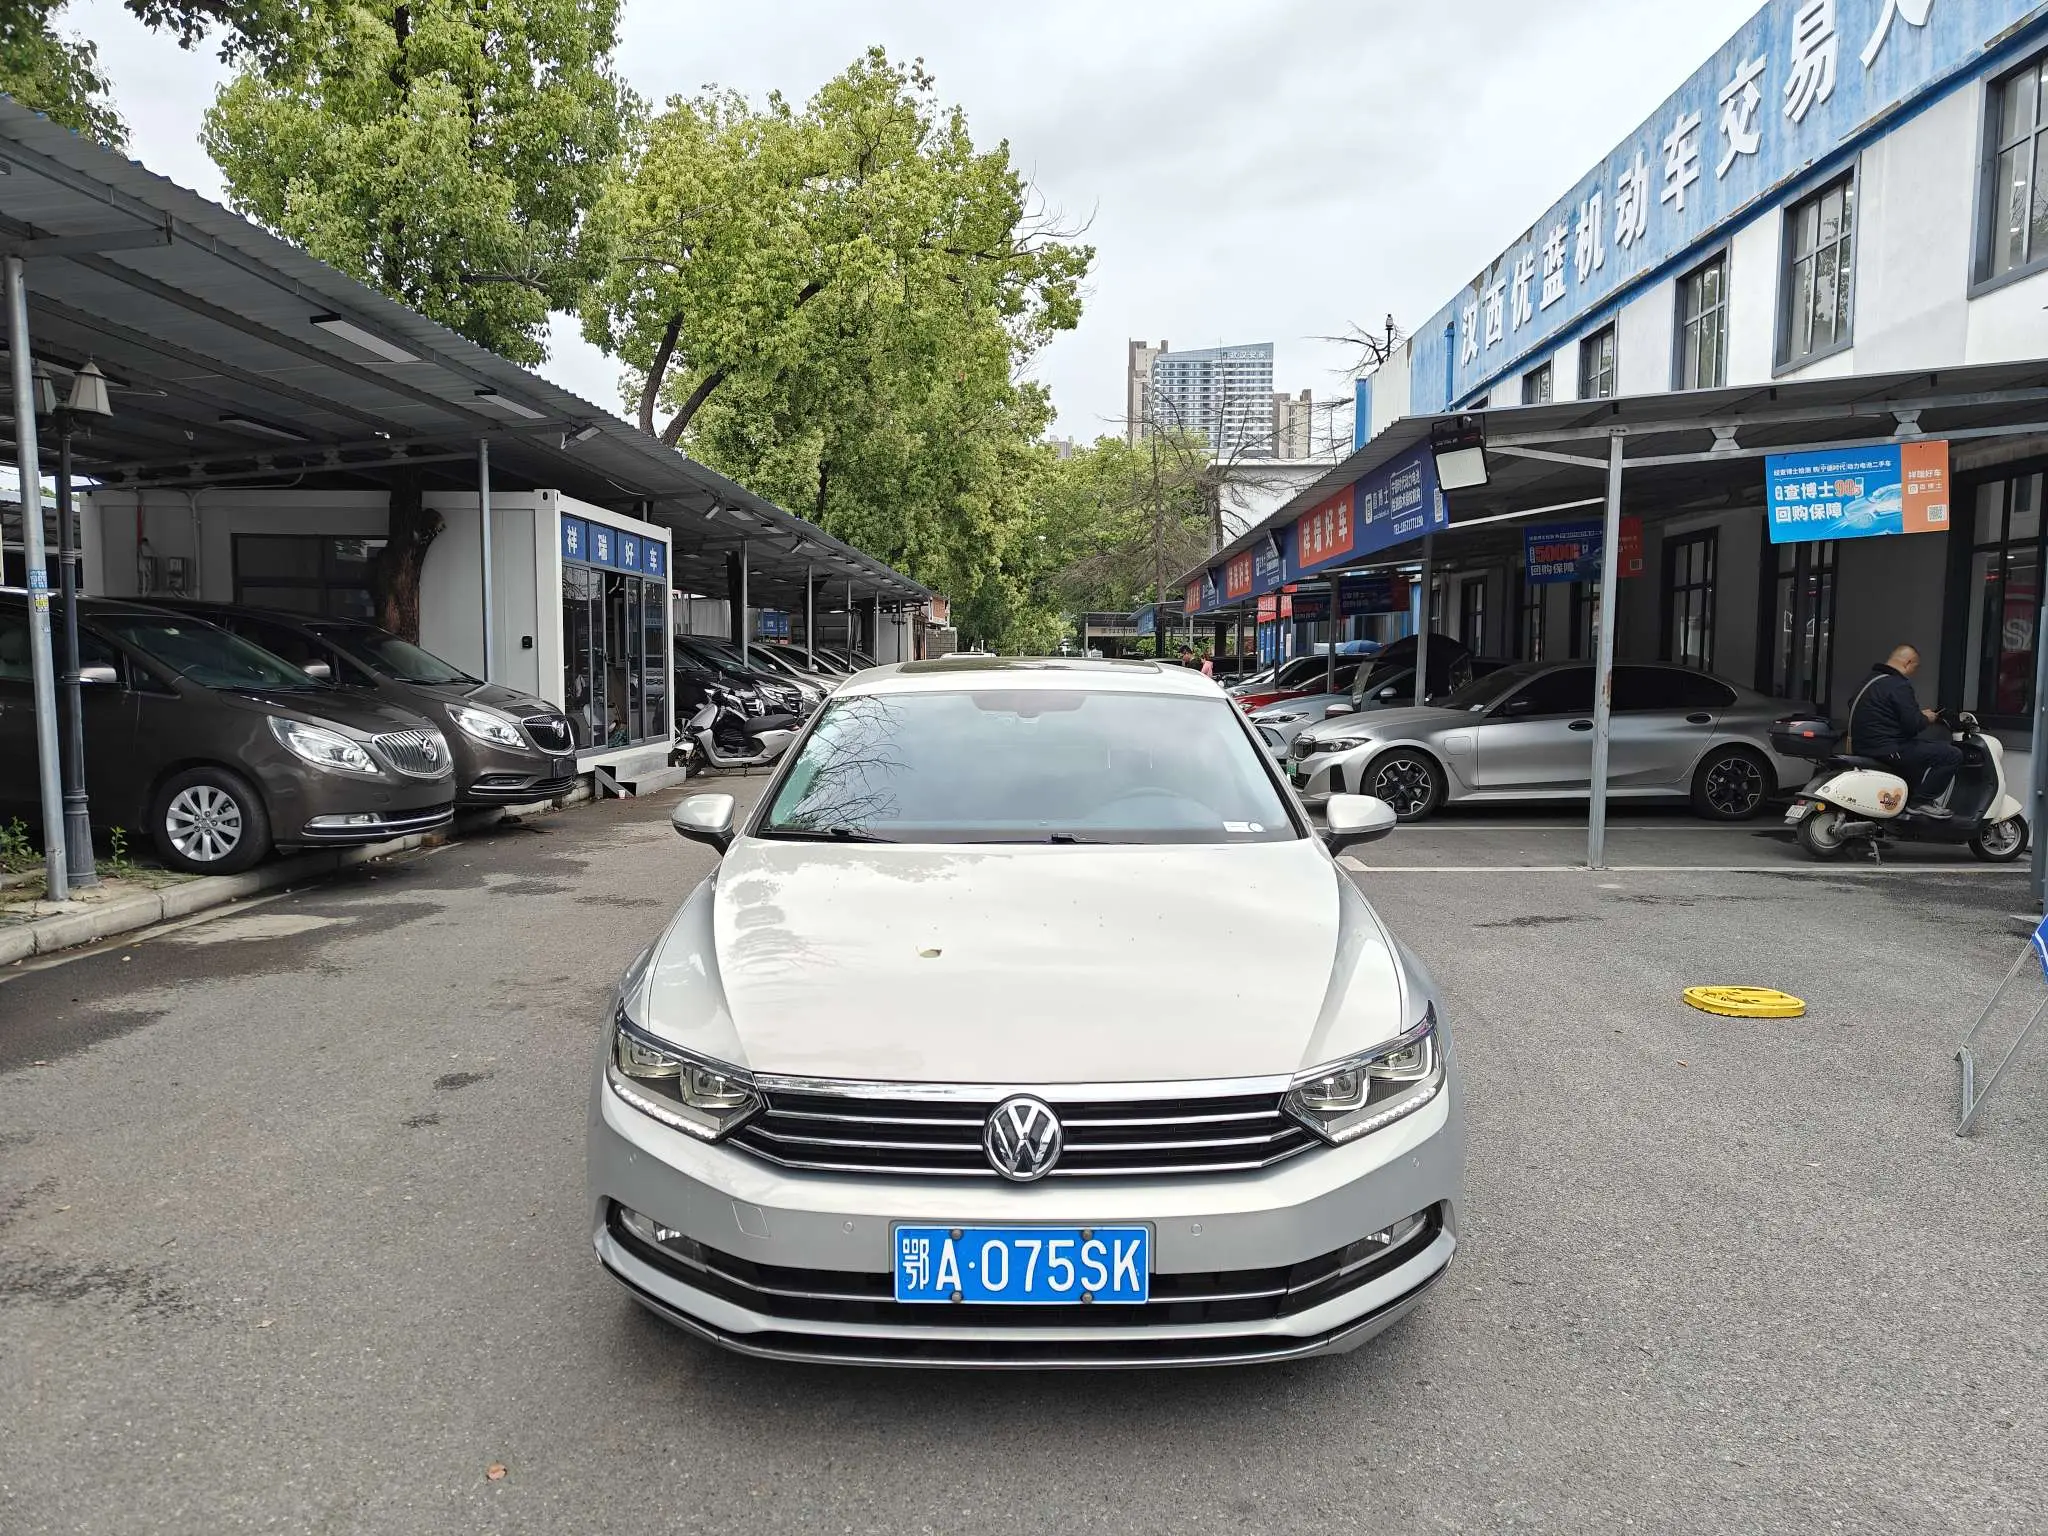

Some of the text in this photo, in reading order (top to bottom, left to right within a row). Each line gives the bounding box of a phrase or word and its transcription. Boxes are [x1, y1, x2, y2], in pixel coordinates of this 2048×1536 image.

[1303, 501, 1348, 558] 祥瑞好车
[1775, 502, 1843, 523] 回购保障
[567, 524, 658, 572] 祥瑞好车
[902, 1237, 1141, 1292] 鄂A·075SK
